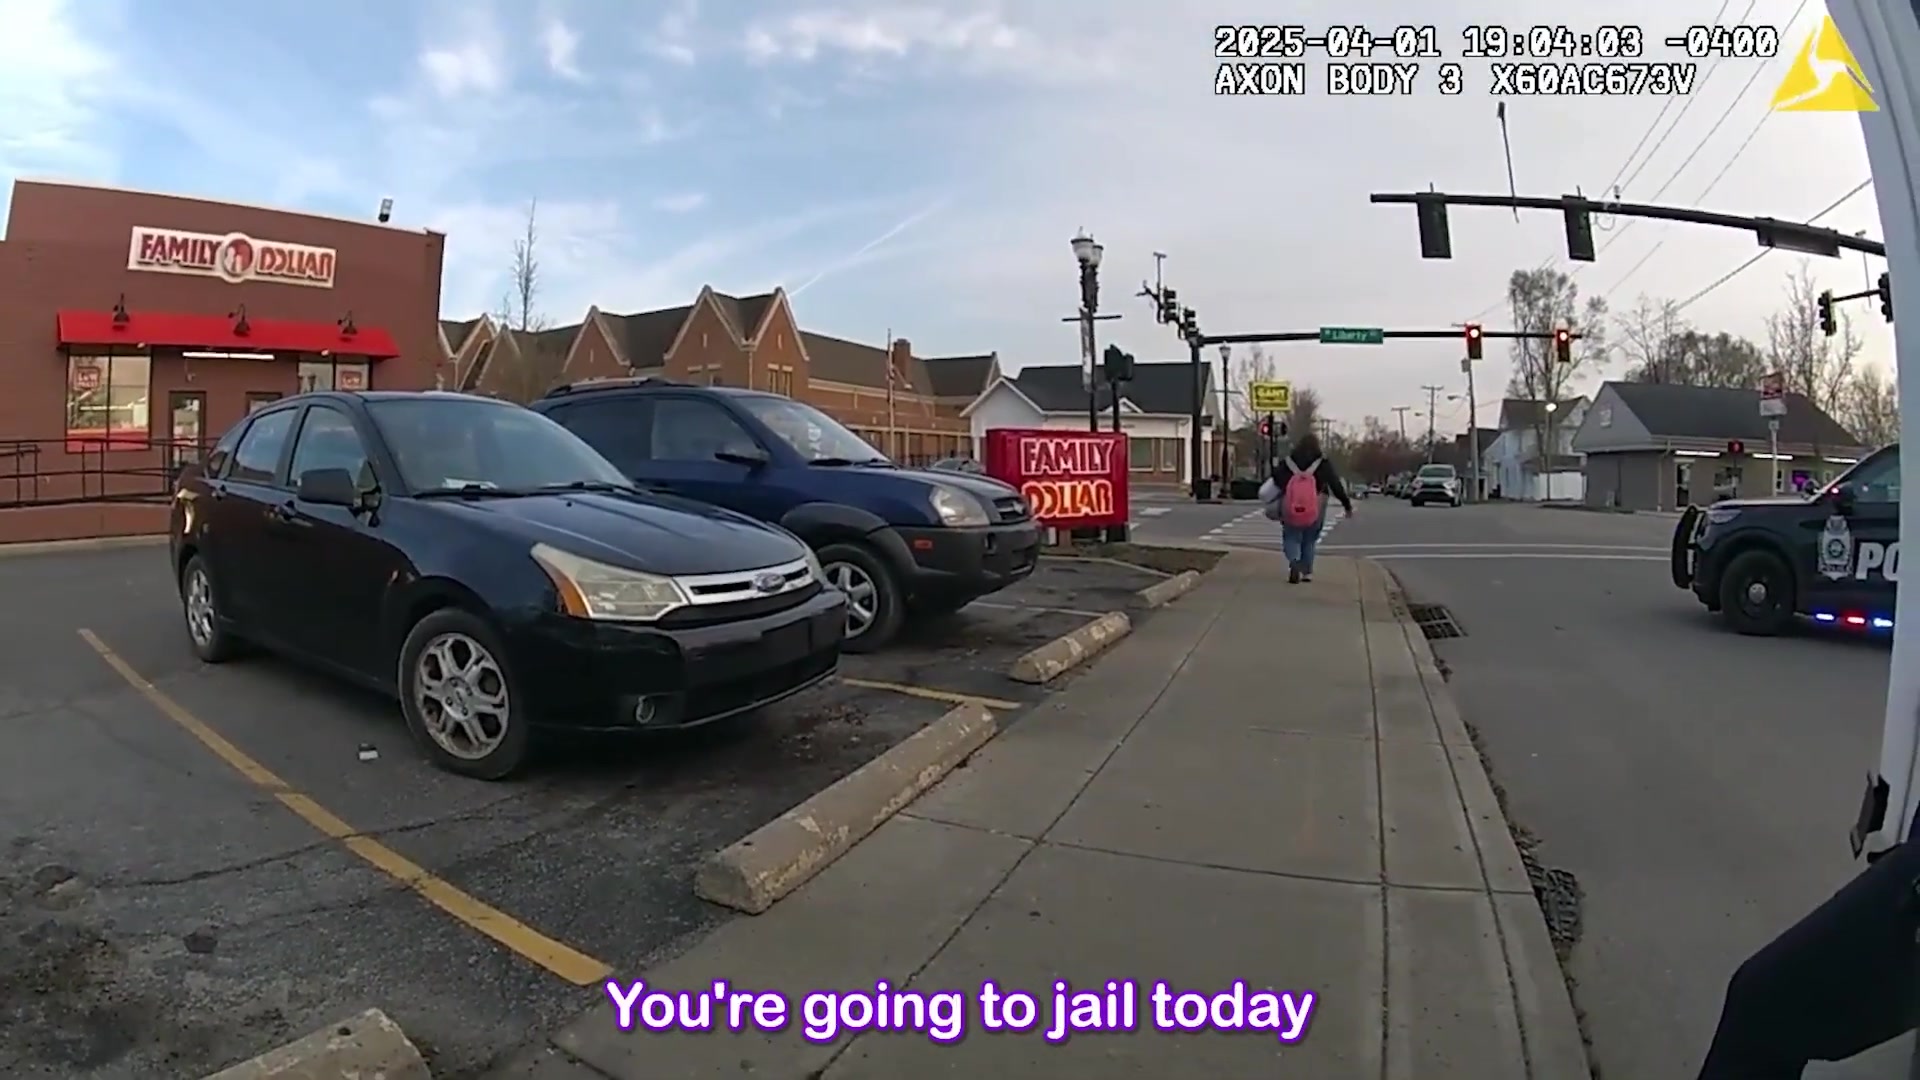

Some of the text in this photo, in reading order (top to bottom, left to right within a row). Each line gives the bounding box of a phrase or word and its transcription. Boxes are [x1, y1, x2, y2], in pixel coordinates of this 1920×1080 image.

[139, 233, 333, 279] FAMILY DOLLAR
[1332, 329, 1369, 341] Liberty
[1021, 438, 1115, 475] FAMILY
[1022, 480, 1114, 519] DOLLAR
